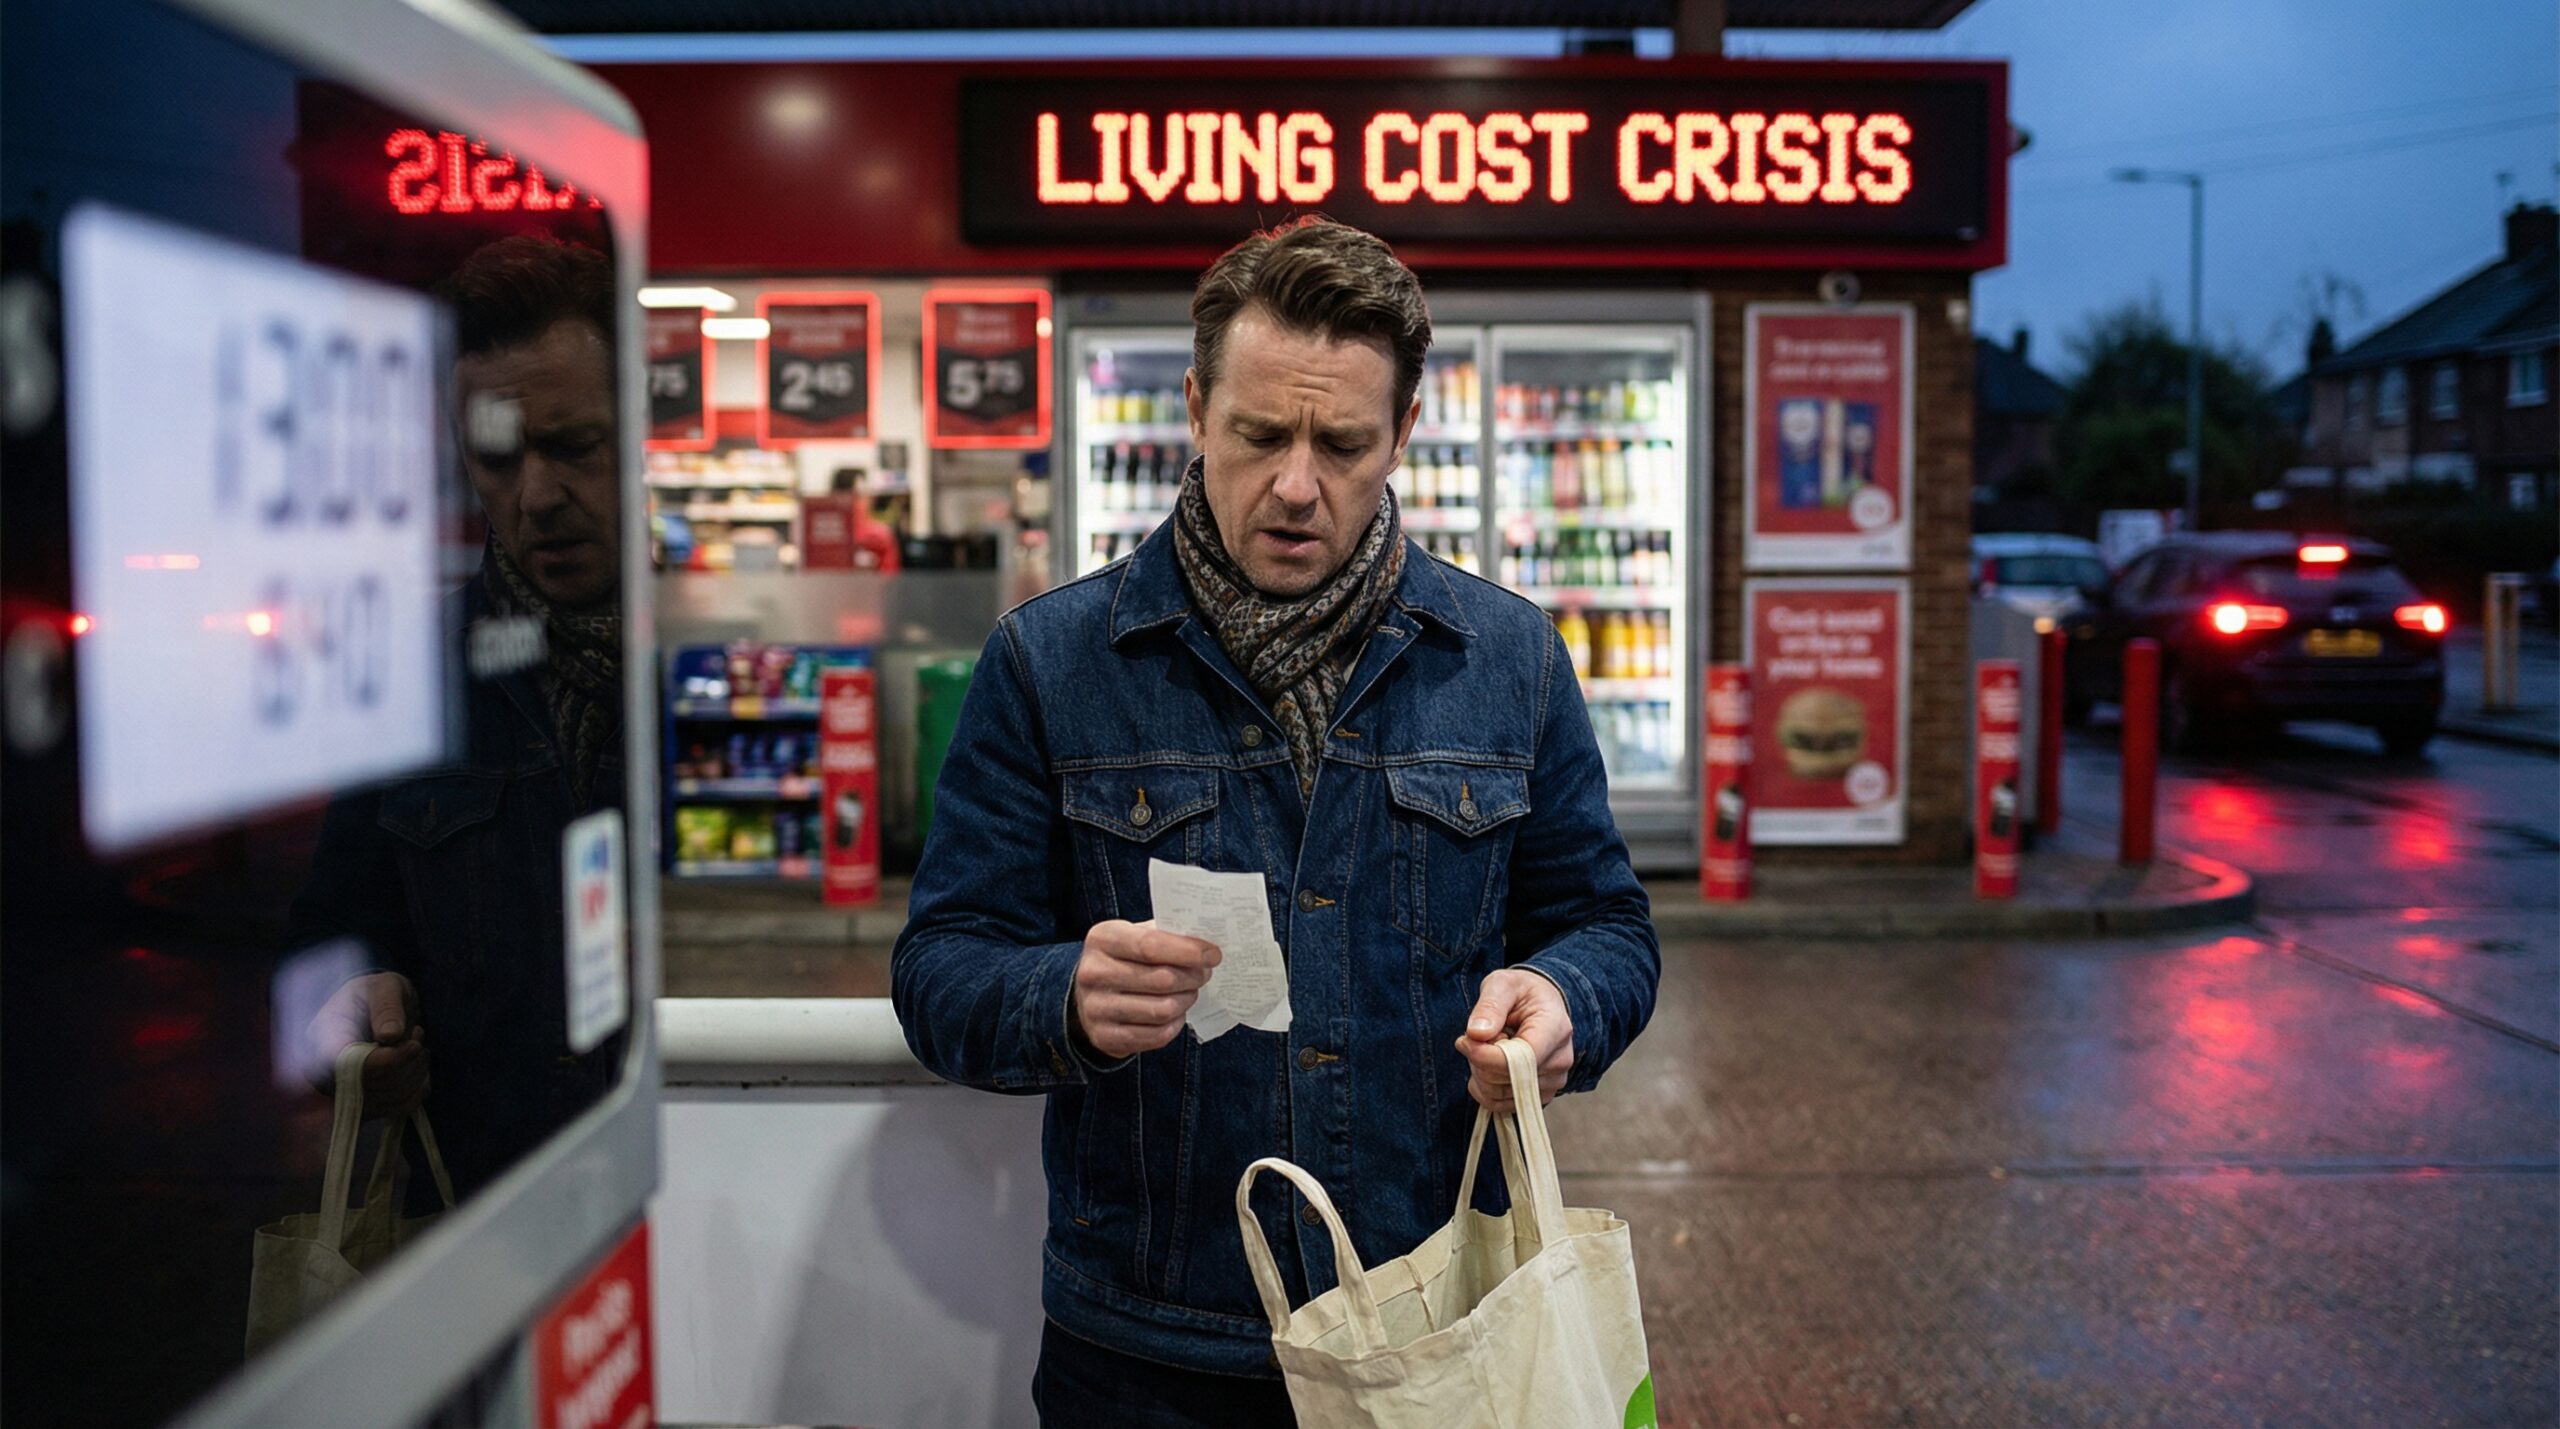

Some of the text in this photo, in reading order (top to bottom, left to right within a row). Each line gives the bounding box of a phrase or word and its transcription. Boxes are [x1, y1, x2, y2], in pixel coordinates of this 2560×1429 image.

[1036, 110, 1914, 204] LIVING COST CRISIS
